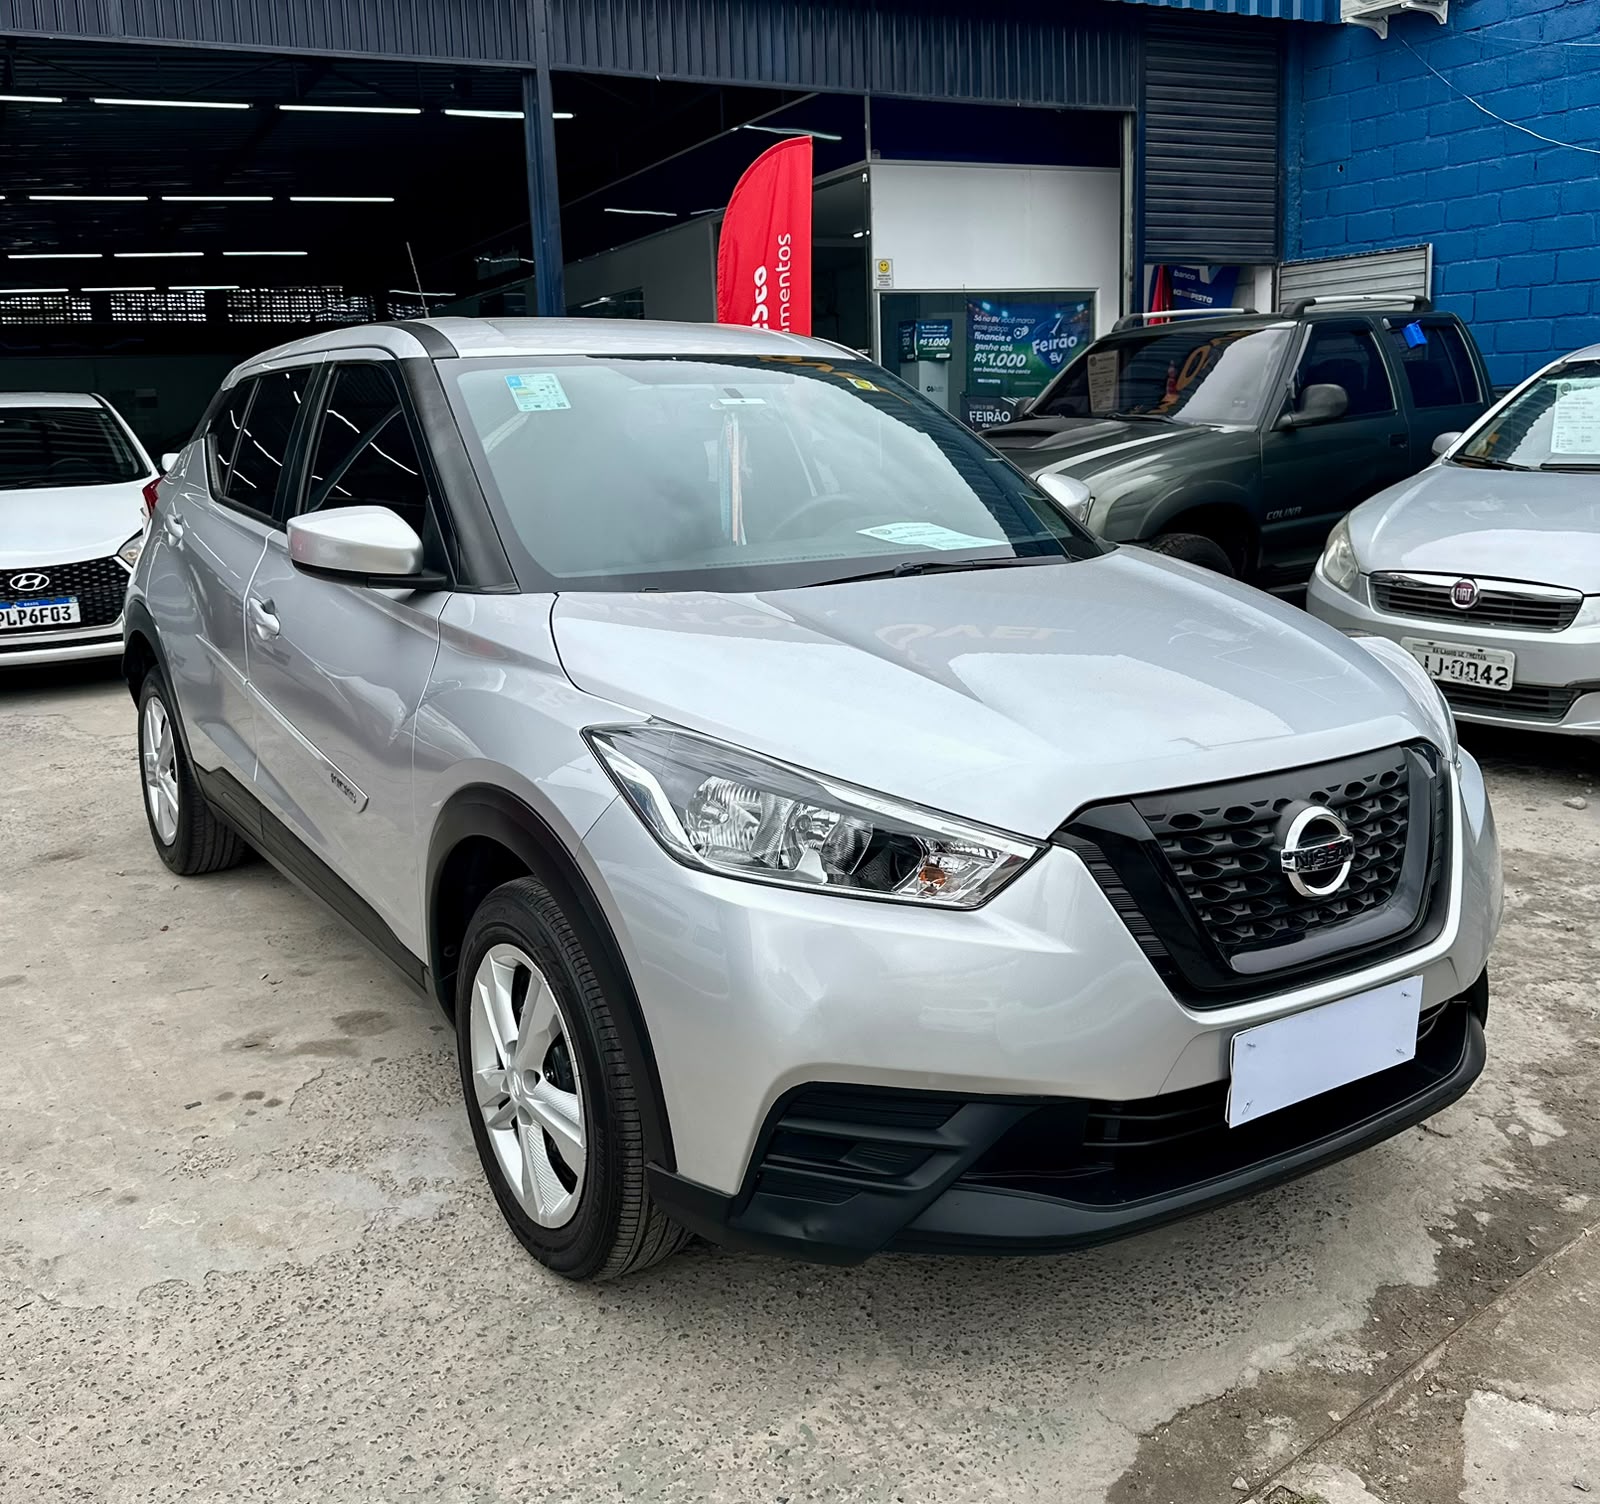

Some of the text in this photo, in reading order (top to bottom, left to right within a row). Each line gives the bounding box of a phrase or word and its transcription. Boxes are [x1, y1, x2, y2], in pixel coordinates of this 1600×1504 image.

[775, 233, 791, 332] mentos
[750, 265, 769, 329] sco
[974, 331, 1005, 342] financie
[1032, 333, 1077, 354] Feirão
[969, 409, 1011, 422] FEIRÃO
[1456, 587, 1473, 600] FIAT
[1294, 839, 1353, 871] NISSAN
